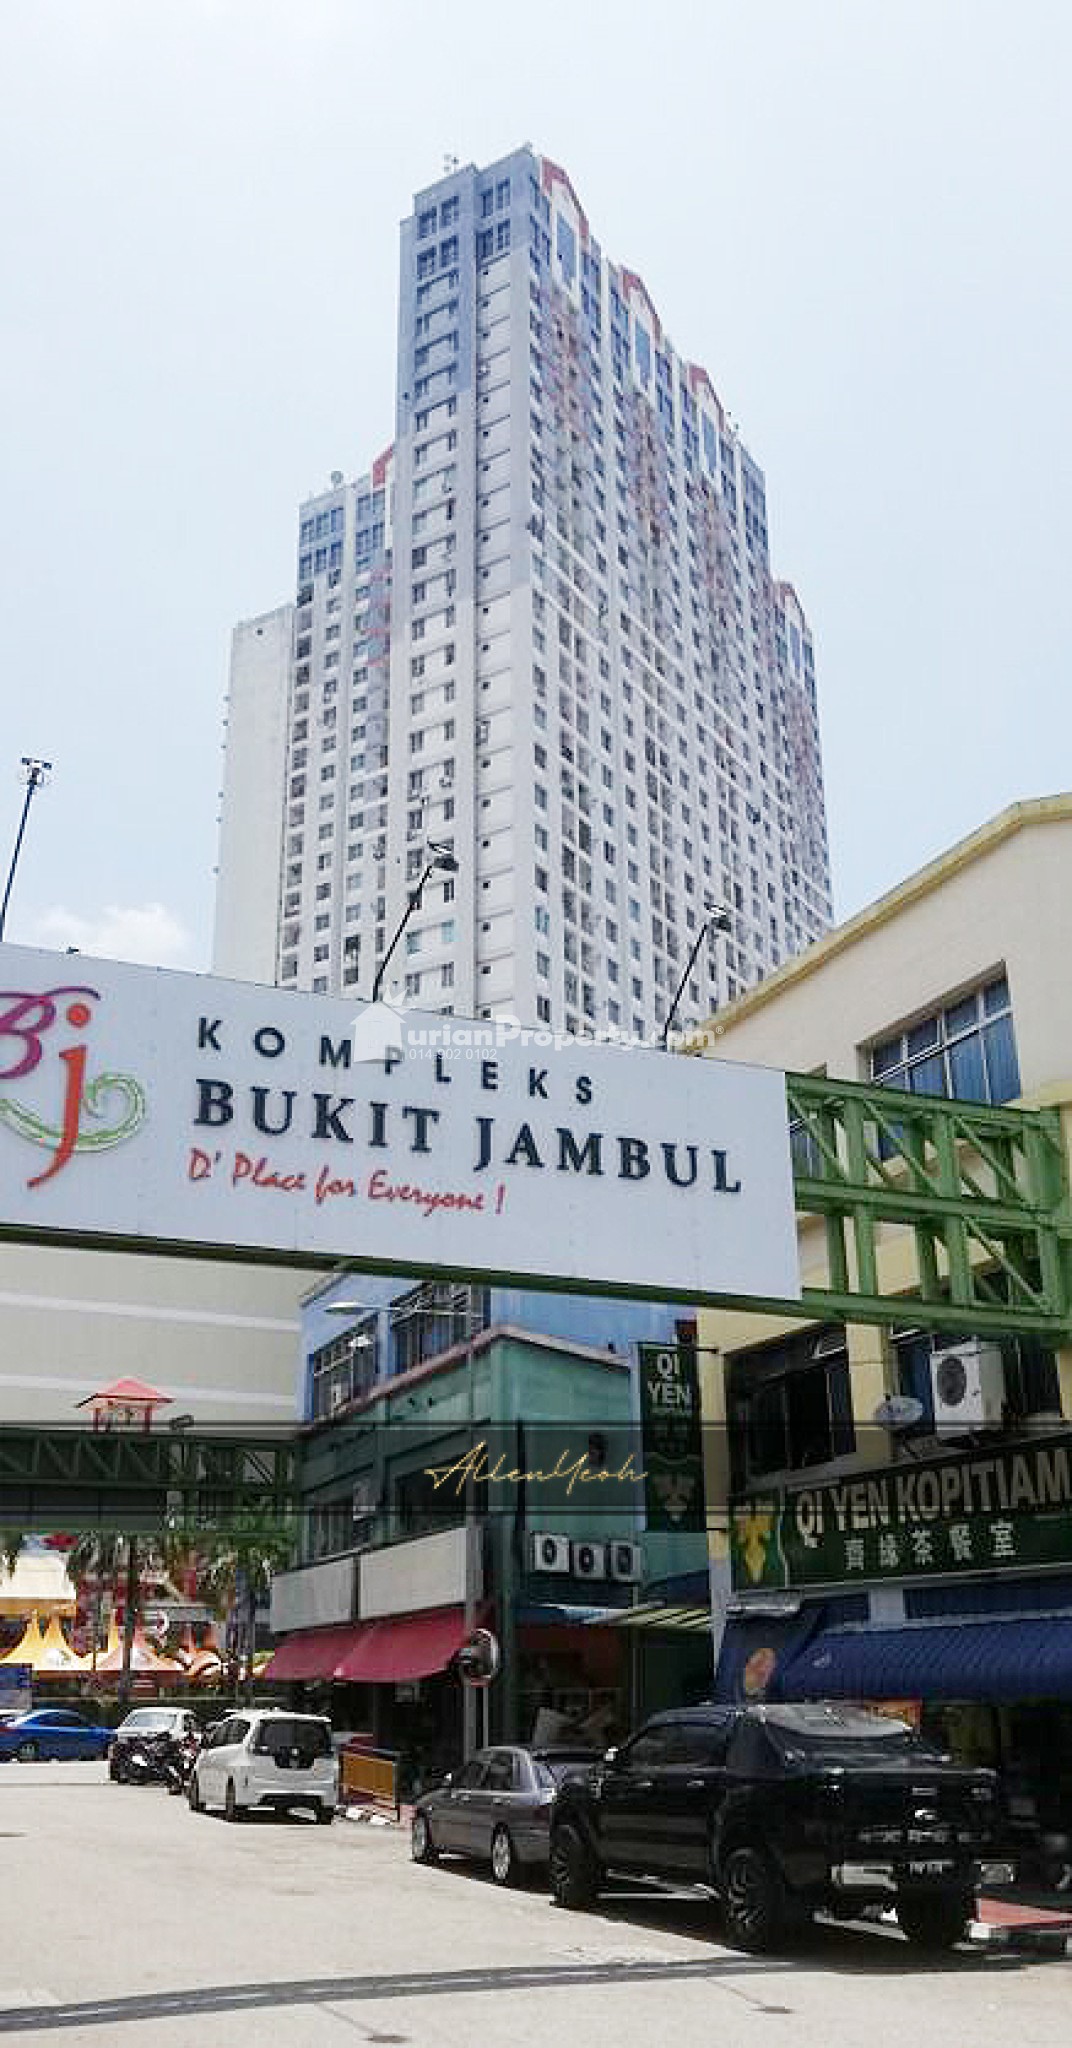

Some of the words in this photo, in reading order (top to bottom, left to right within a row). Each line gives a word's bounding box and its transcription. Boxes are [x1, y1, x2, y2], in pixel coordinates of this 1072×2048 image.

[197, 1017, 593, 1105] KOMPLEKS
[193, 1078, 441, 1154] BUKIT
[472, 1115, 742, 1194] JAMBUL
[232, 1151, 306, 1189] Place
[314, 1164, 357, 1207] for
[367, 1169, 485, 1217] Everyone
[647, 1381, 692, 1407] YEN
[656, 1352, 681, 1381] QI
[796, 1490, 824, 1548] QI
[829, 1477, 890, 1531] YEN
[896, 1446, 1072, 1524] KOPITIAM
